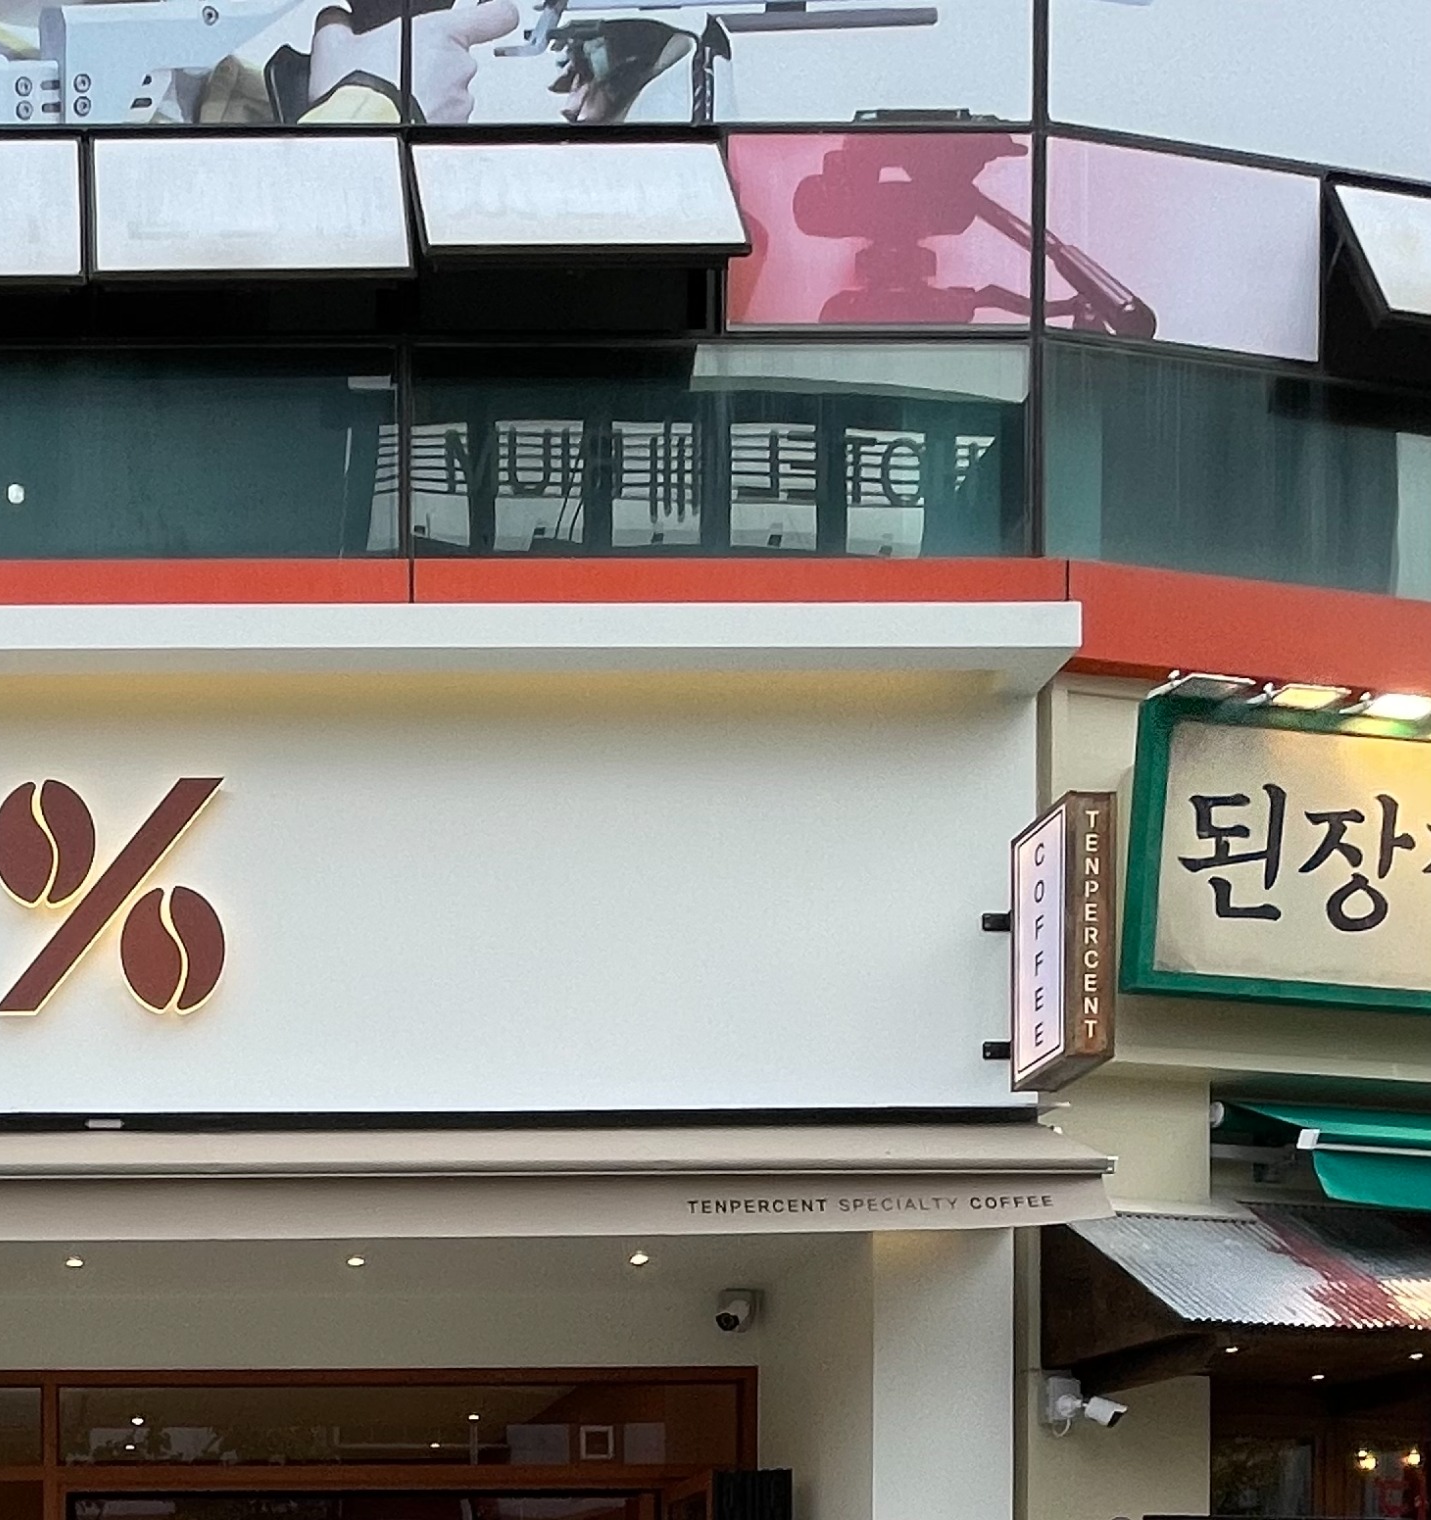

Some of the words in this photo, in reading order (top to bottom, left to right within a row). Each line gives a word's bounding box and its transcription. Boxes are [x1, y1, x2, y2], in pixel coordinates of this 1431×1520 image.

[1033, 843, 1045, 1047] COFFEE
[1084, 809, 1102, 1039] TENPERCENT
[1177, 783, 1431, 931] 된장
[687, 1199, 827, 1214] TENPERCENT
[839, 1197, 958, 1212] SPECIALTY
[969, 1195, 1054, 1210] COFFEE
